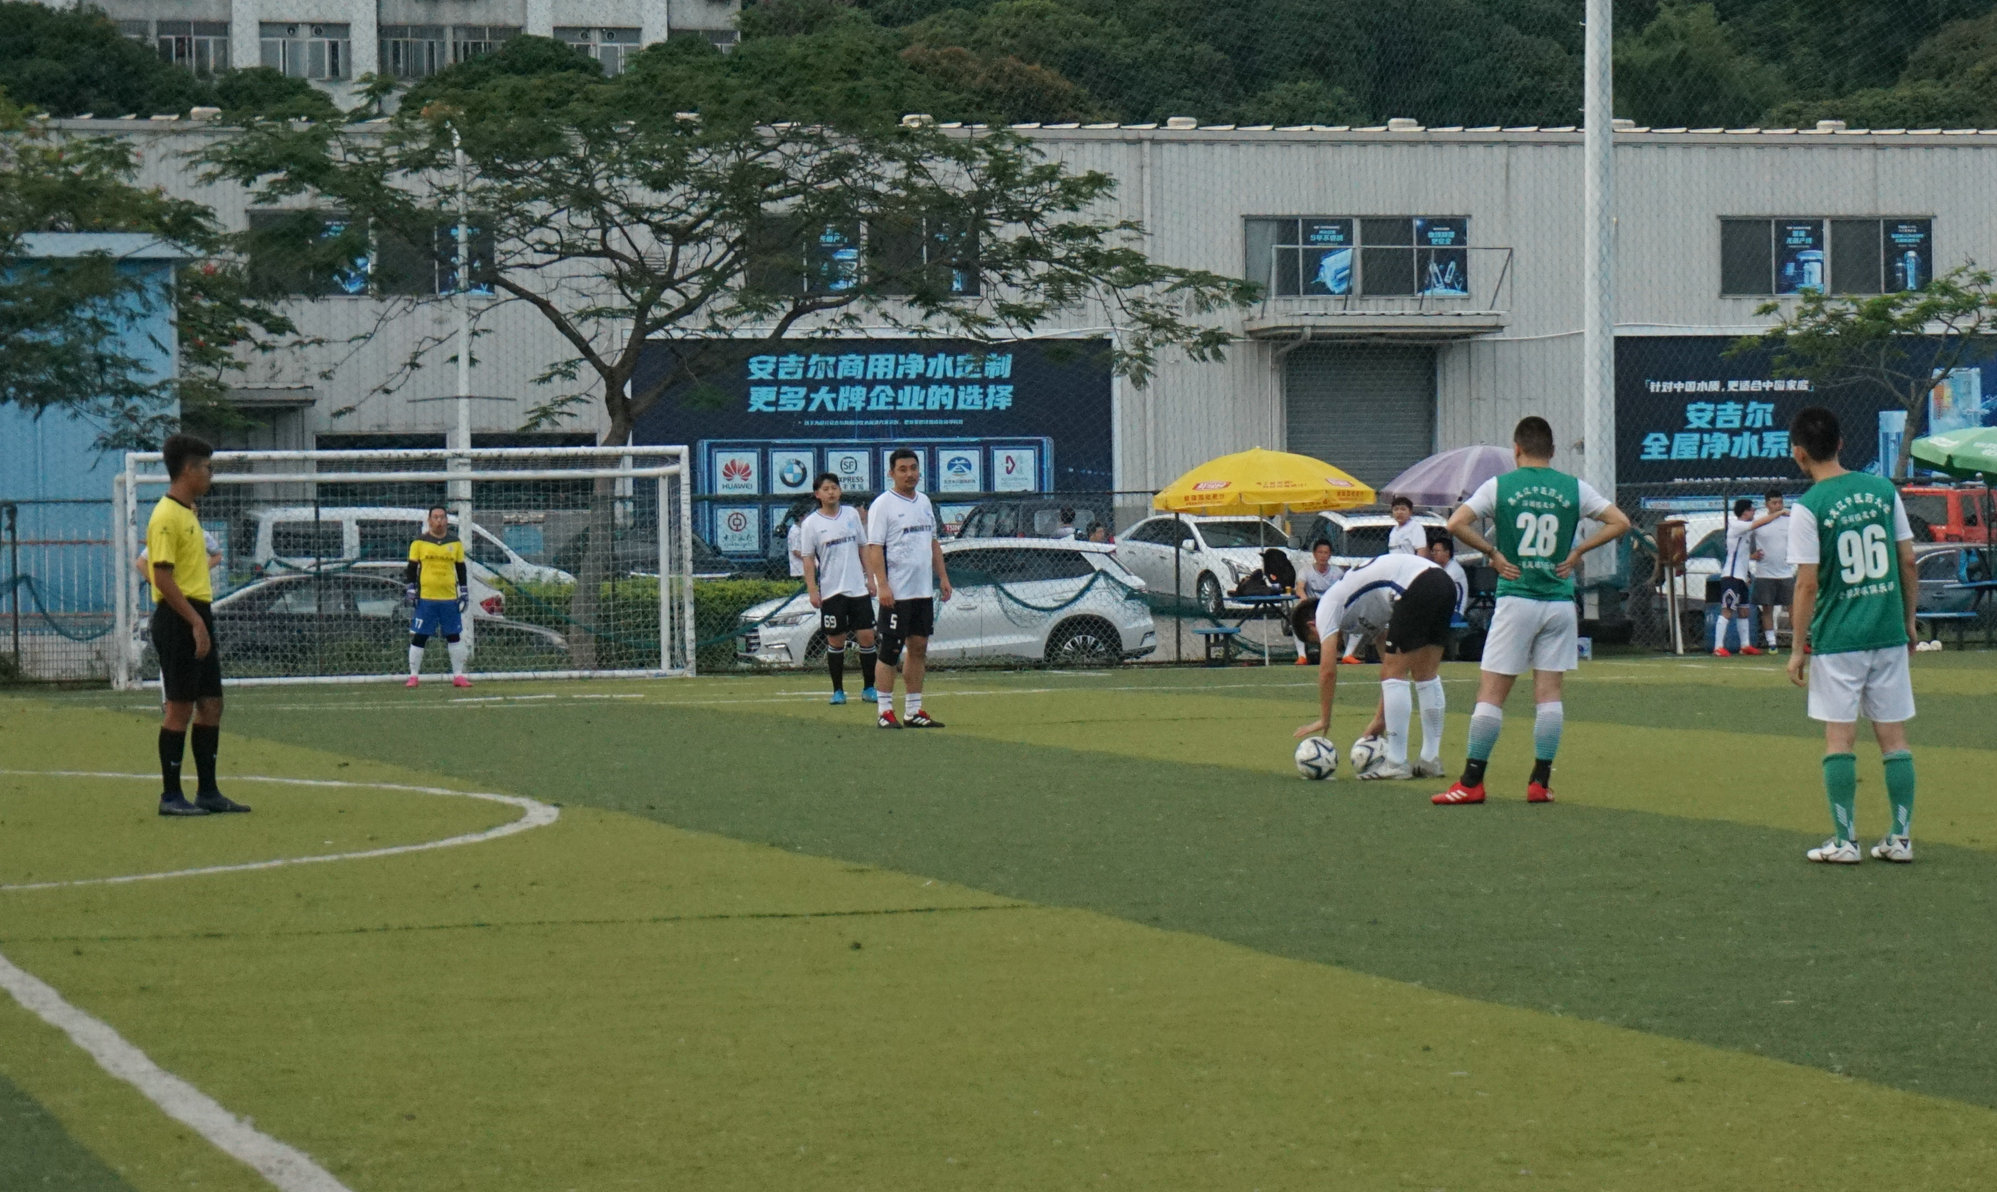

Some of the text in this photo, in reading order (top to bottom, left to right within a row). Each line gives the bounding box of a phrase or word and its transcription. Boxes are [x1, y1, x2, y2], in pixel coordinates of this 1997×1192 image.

[747, 385, 1014, 412] 更多大牌企业的选择
[1684, 401, 1774, 429] 安吉尔
[1640, 431, 1796, 460] 全屋净水系
[837, 476, 864, 484] XPRESS
[1516, 511, 1559, 557] 28
[1837, 523, 1890, 585] 96
[823, 615, 837, 629] 69
[889, 614, 899, 630] 5
